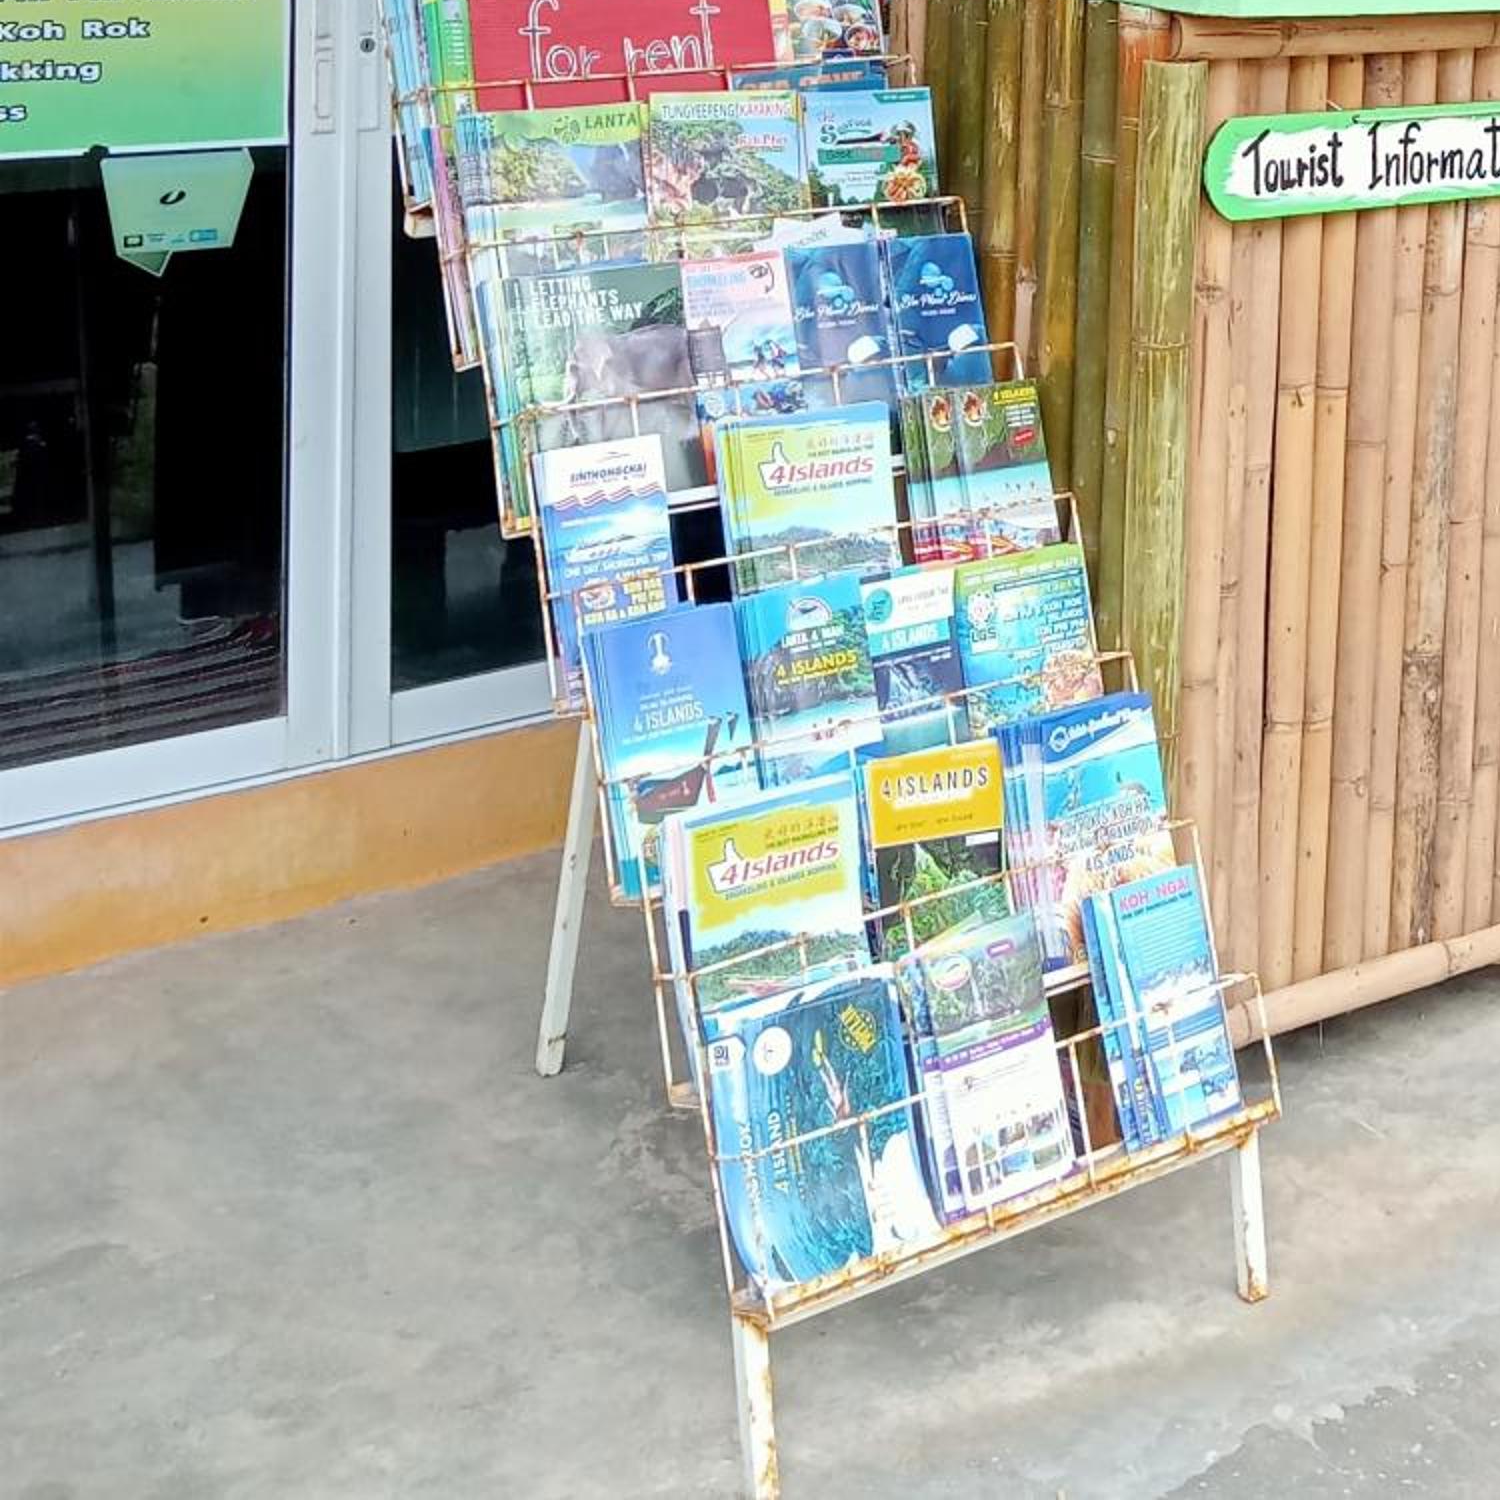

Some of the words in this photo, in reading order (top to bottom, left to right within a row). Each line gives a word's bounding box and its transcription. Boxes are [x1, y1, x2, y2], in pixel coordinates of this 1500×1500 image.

[82, 18, 151, 41] Rok
[584, 111, 637, 130] LANTA
[1241, 127, 1345, 197] Tourist
[531, 288, 620, 311] ELEPHANTS
[610, 302, 644, 320] WAY
[897, 766, 989, 797] ISLANDS
